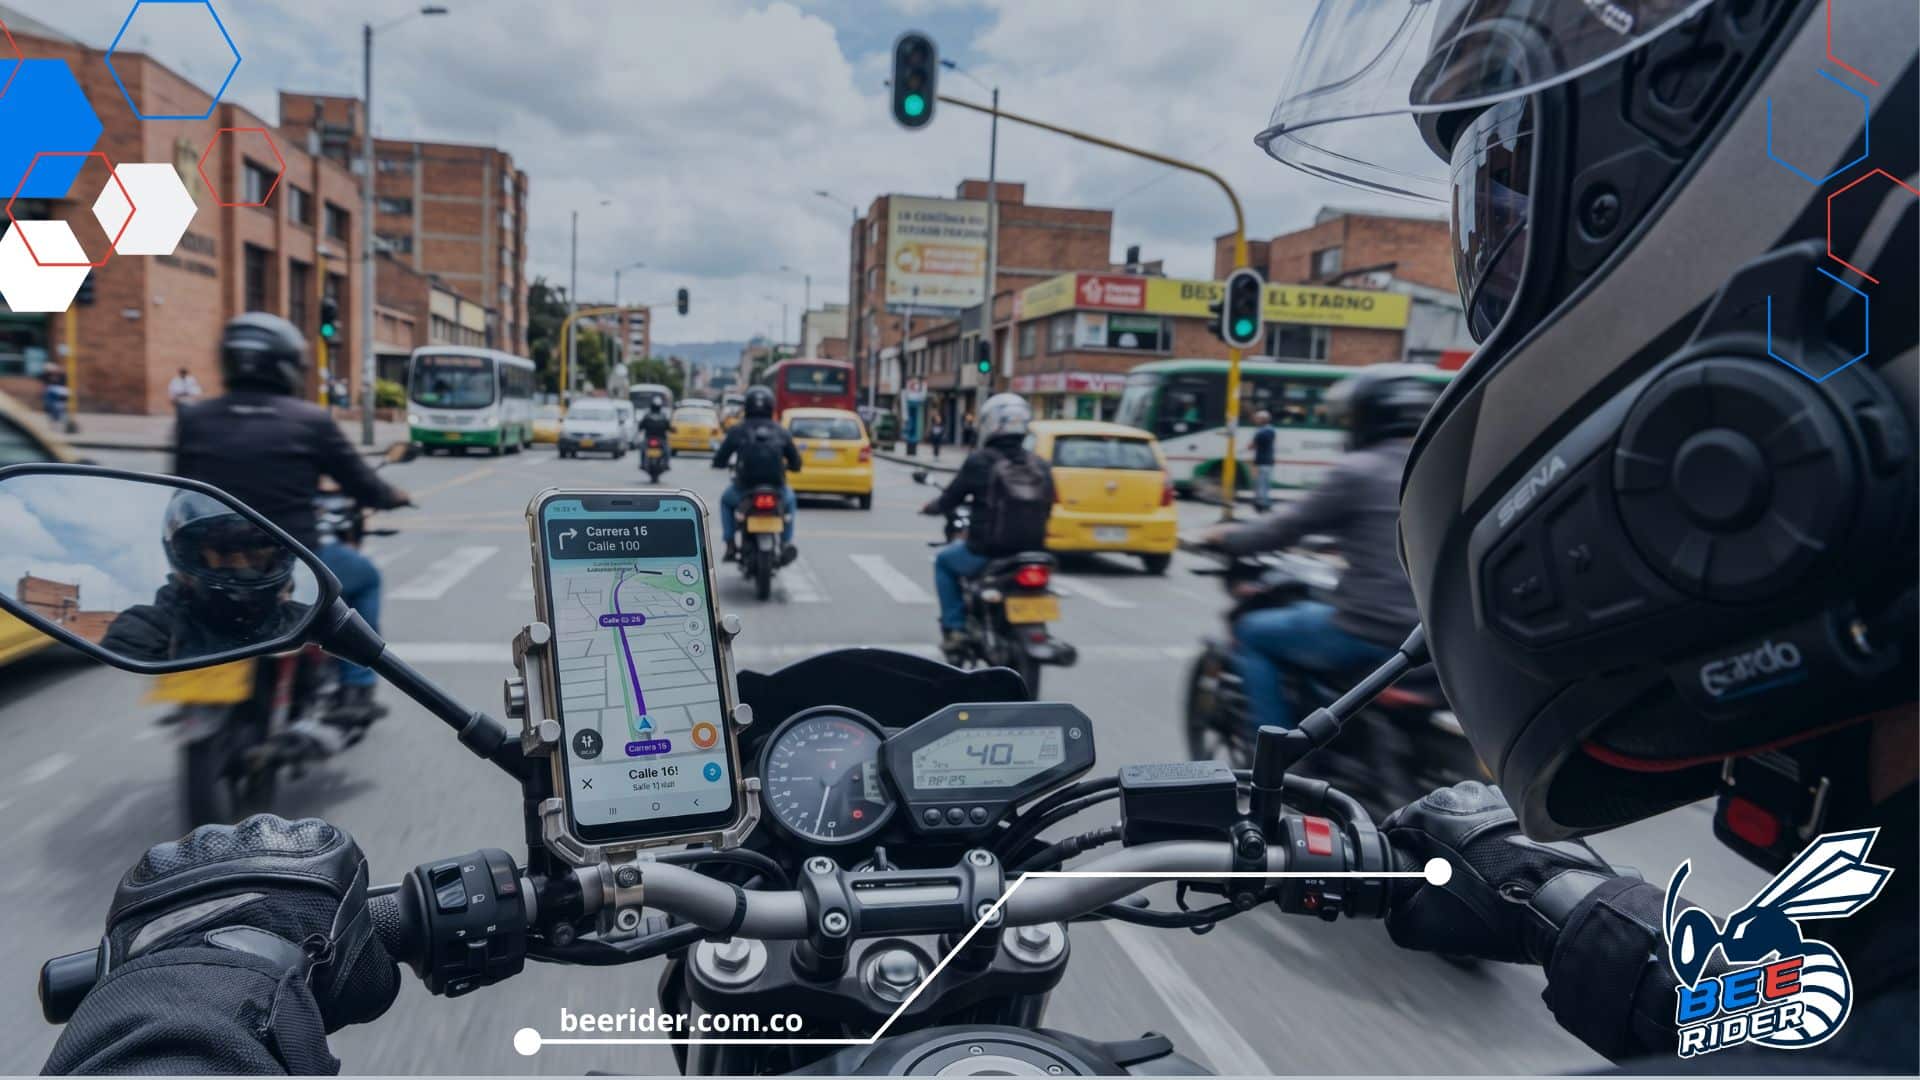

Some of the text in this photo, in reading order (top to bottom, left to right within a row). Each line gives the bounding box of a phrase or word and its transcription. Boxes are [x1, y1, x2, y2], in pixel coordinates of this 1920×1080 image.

[1498, 455, 1567, 528] SENA
[586, 526, 630, 537] Carrera
[587, 540, 640, 552] Calle 100
[628, 744, 657, 753] Carrera
[966, 743, 1013, 766] 40
[628, 768, 658, 780] Calle
